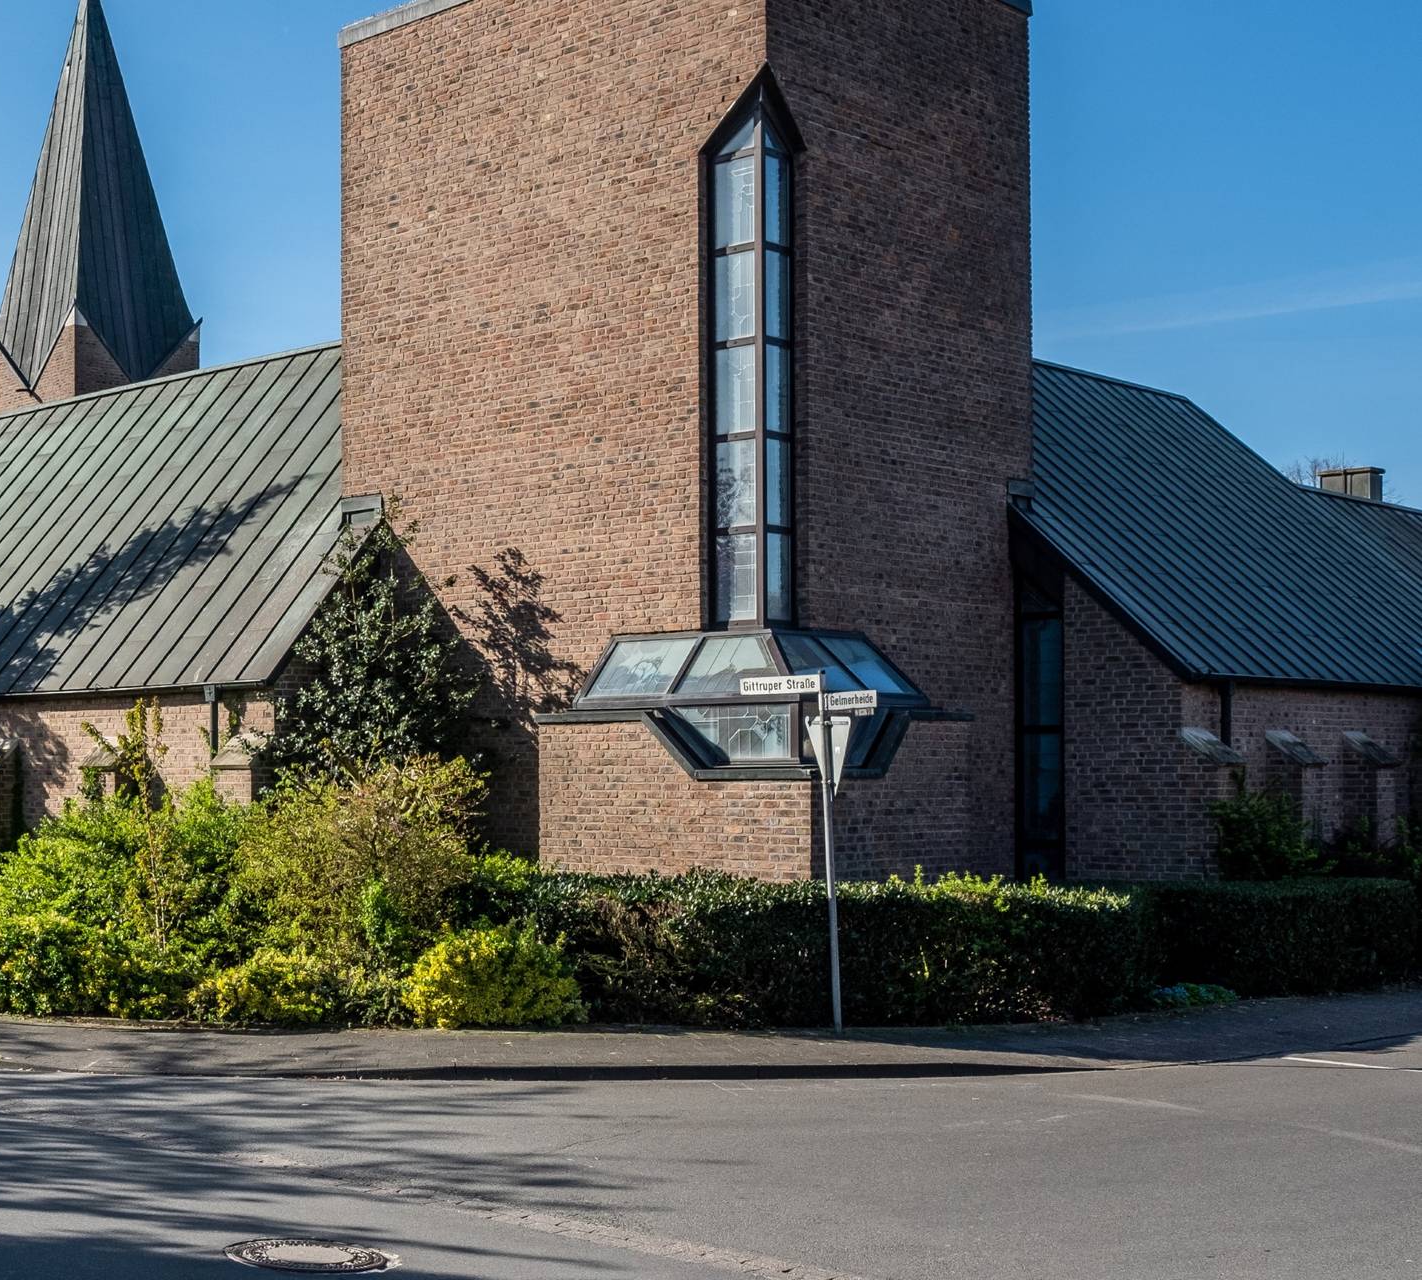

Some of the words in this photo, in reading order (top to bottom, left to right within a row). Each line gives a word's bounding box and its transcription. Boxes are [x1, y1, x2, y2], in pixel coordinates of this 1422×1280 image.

[743, 680, 782, 692] Gittruper
[786, 678, 816, 689] Straße
[830, 693, 874, 706] Gelmerheide
